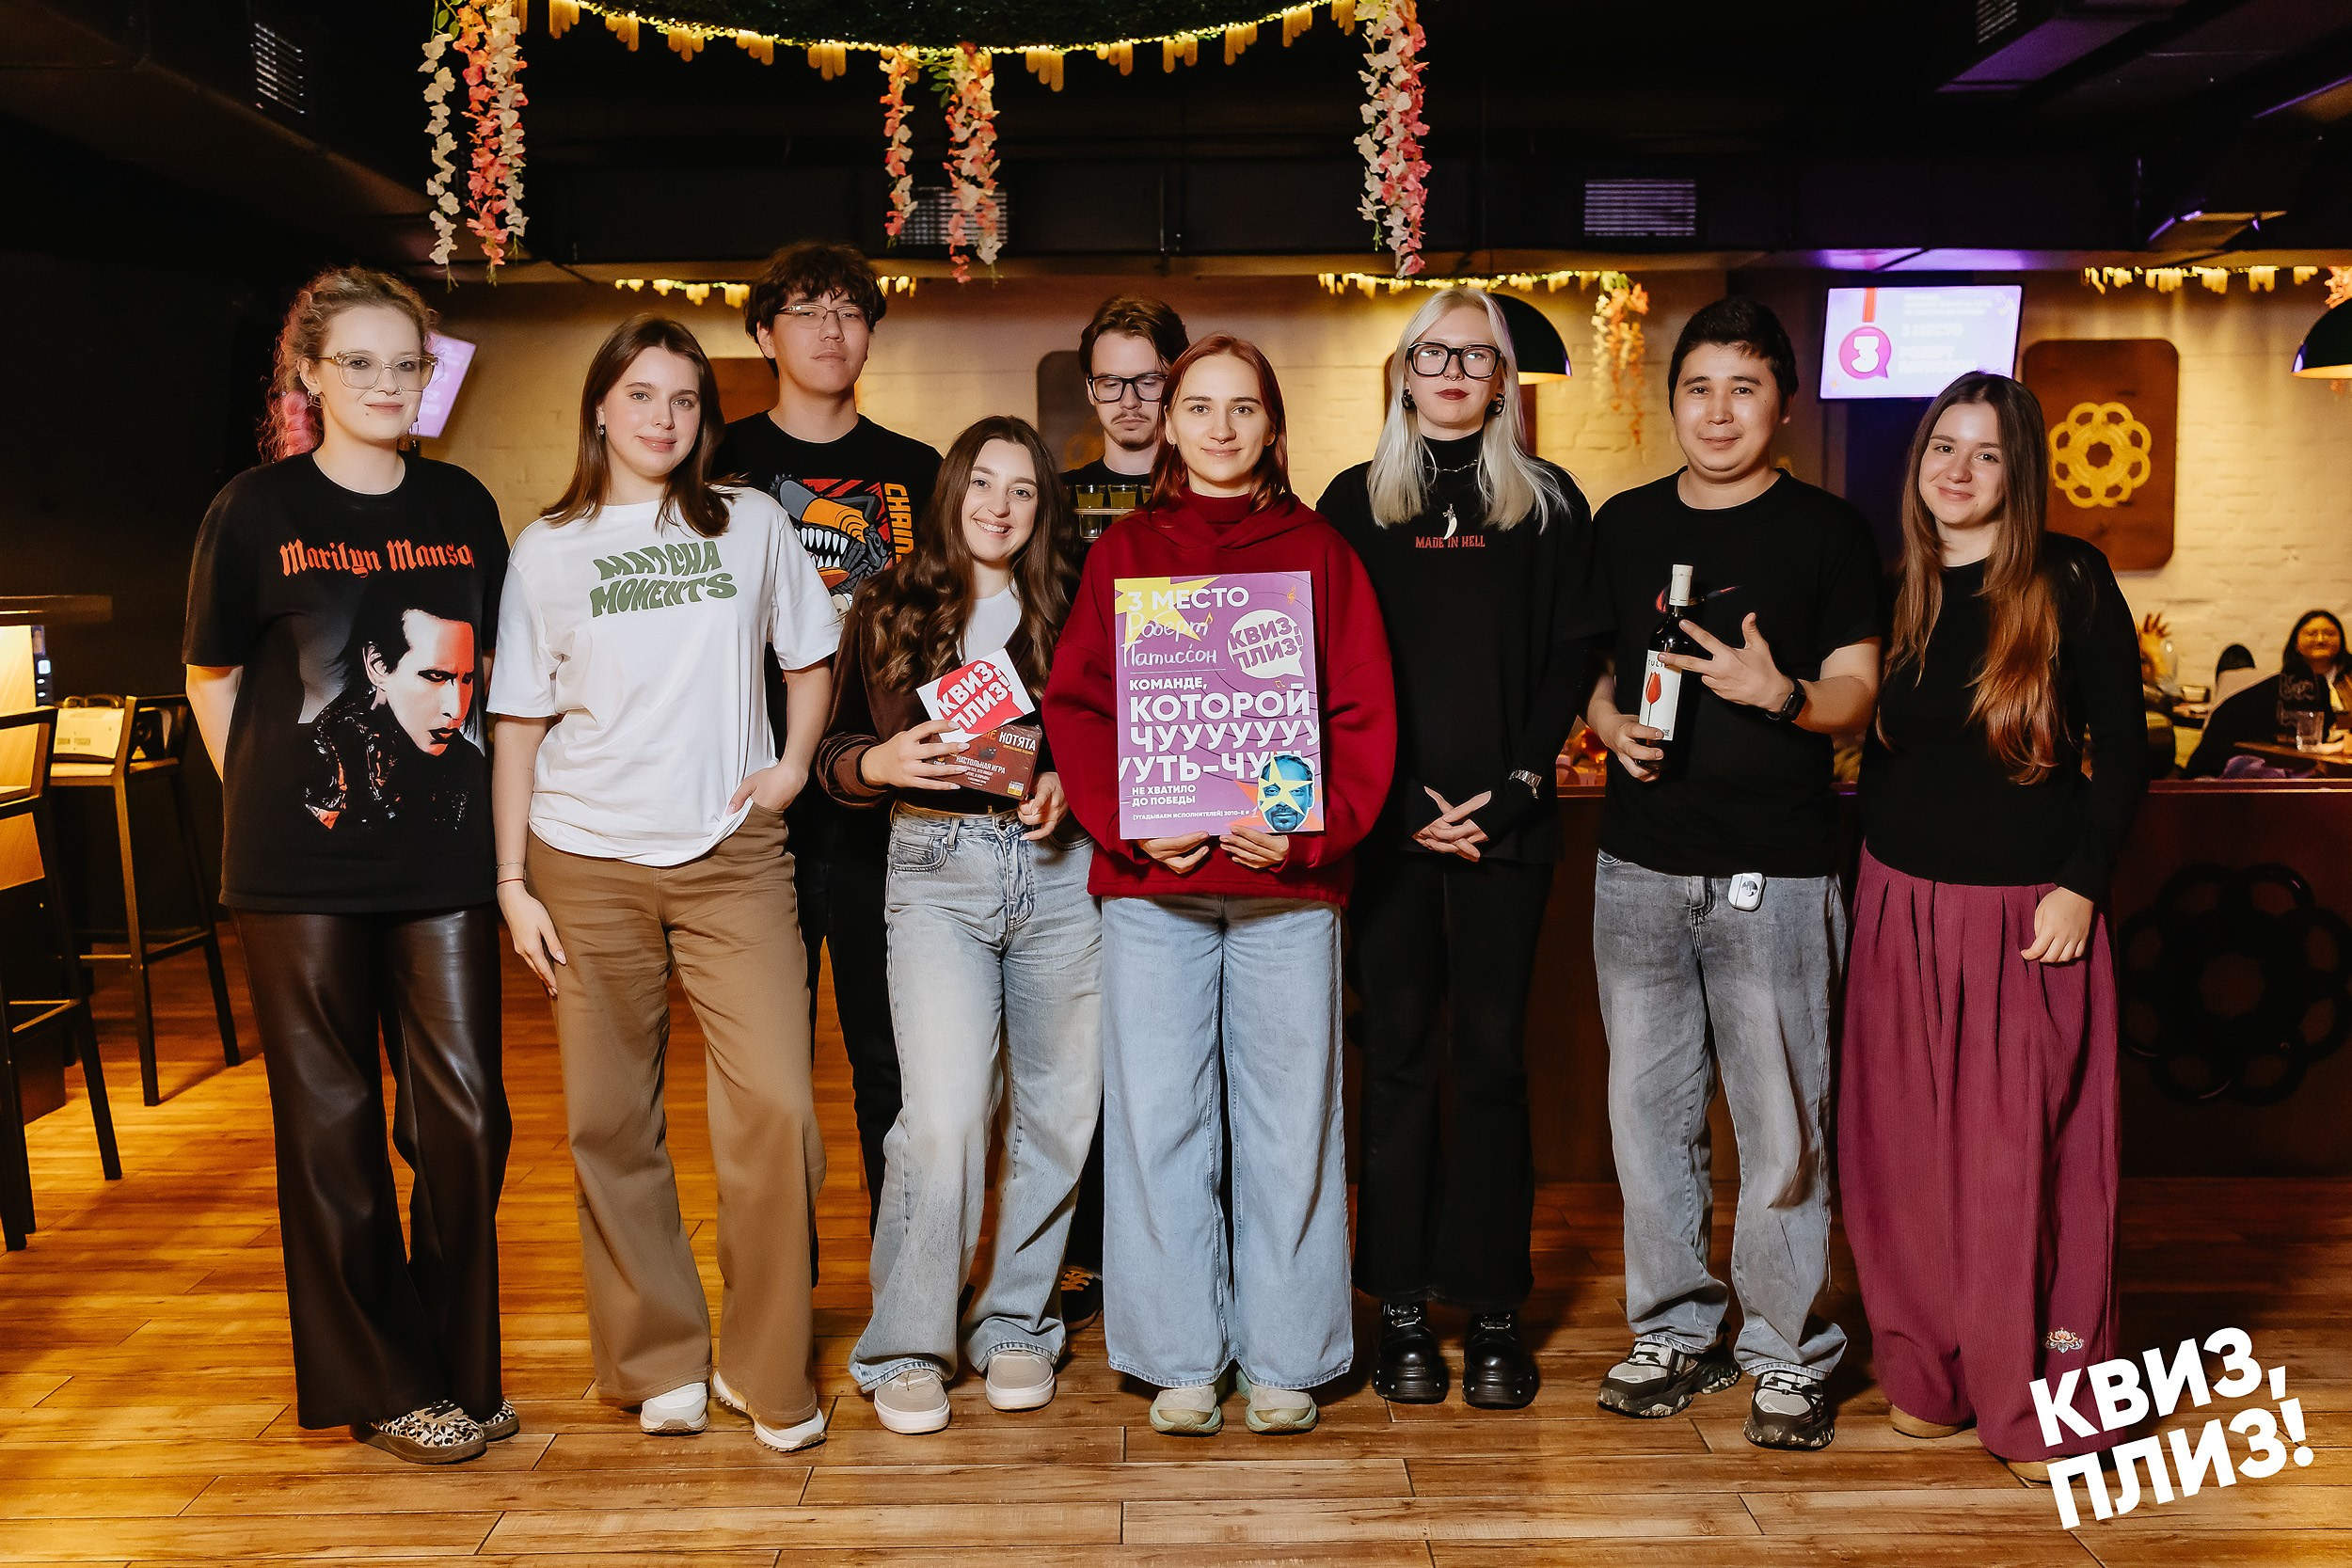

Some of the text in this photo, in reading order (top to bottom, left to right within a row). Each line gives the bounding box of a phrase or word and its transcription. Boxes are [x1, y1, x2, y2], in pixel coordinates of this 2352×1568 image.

[1851, 335, 1880, 373] 3
[884, 483, 914, 564] CHAIN
[279, 538, 382, 578] Marilyn
[1415, 534, 1486, 548] MADE IN HELL
[593, 540, 723, 581] MATCHA
[589, 573, 738, 618] MOMENTS
[1127, 586, 1250, 611] 3 МЕСТО
[1127, 610, 1210, 642] Роберт
[1230, 617, 1299, 651] КВИЗ,
[1120, 640, 1217, 668] Патиссон
[1232, 634, 1304, 671] ПЛИЗ!
[937, 662, 1004, 717] КВИЗ,
[1129, 676, 1208, 691] КОМАНДЕ,
[950, 674, 1012, 730] ПЛИЗ!
[1130, 683, 1311, 722] КОТОРОЙ
[999, 731, 1036, 752] КОТЯТА
[956, 755, 993, 770] НАСТОЛЬНАЯ
[991, 762, 1006, 774] ИГРА
[1132, 784, 1197, 796] НЕ ХВАТИЛО
[1132, 795, 1196, 808] ДО ПОБЕДЫ
